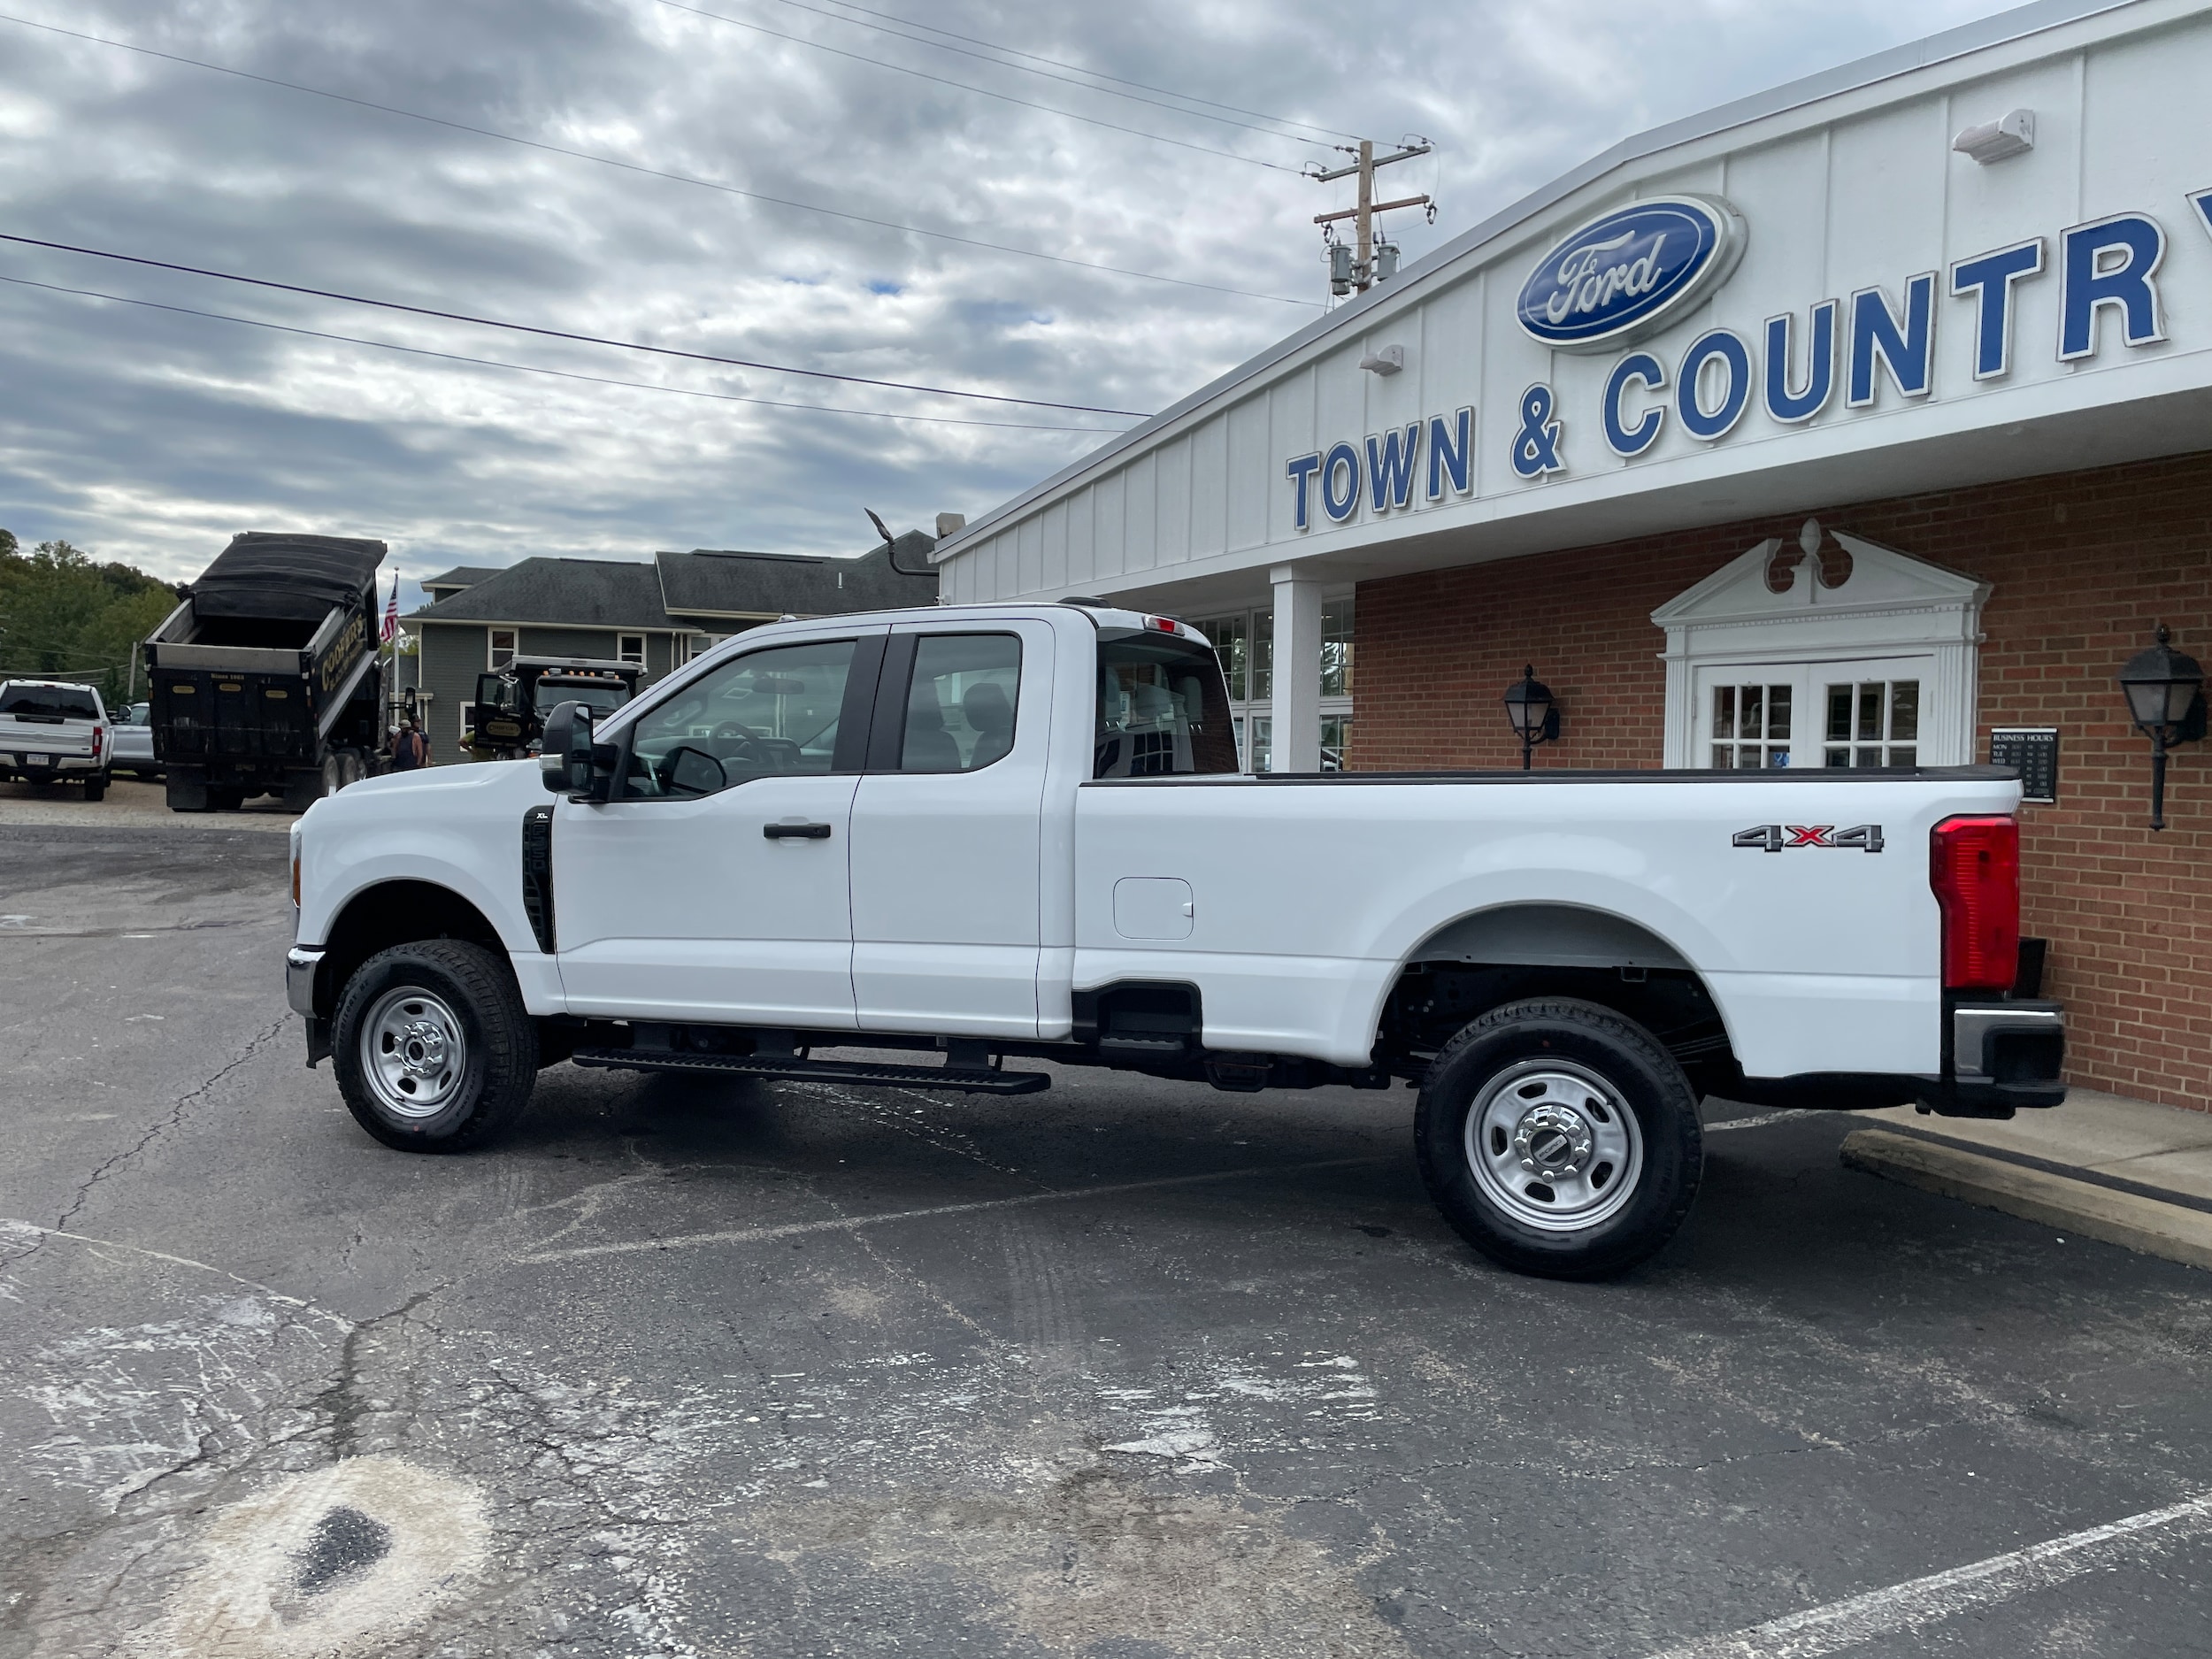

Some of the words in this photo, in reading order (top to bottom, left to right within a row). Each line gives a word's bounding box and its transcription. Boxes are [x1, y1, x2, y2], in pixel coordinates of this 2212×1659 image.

[1286, 404, 1475, 531] TOWN
[1510, 380, 1568, 480] &
[1600, 188, 2212, 460] COUNTR
[1547, 229, 1667, 325] Ford
